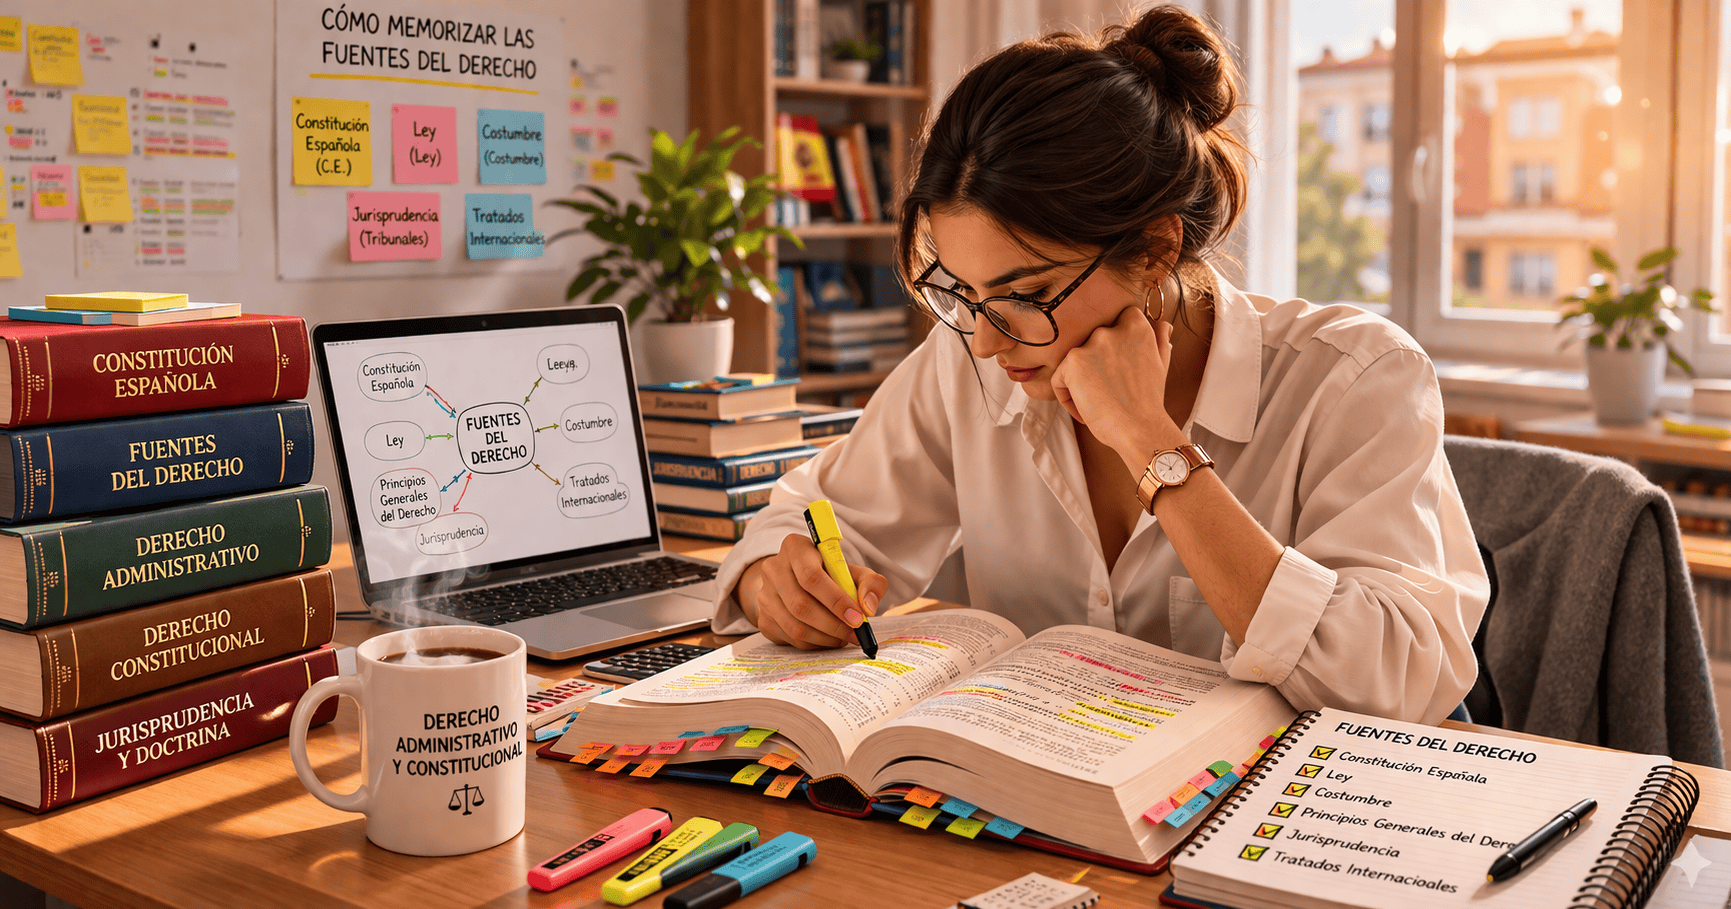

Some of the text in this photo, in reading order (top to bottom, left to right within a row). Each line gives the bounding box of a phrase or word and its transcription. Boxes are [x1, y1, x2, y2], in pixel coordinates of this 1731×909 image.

[322, 4, 534, 49] CÓMO MEMORIZAR LAS
[323, 42, 536, 79] FUENTES DEL DERECHO
[296, 113, 369, 131] Constitución
[414, 122, 436, 142] Ley
[482, 124, 542, 141] Costumbre
[306, 136, 360, 154] Española
[316, 158, 351, 176] (C.E.)
[410, 147, 441, 167] (Ley)
[484, 150, 543, 167] (Costumbre)
[353, 207, 438, 226] Jurisprudencia
[472, 208, 524, 223] Tratados
[360, 230, 428, 248] (Tribunales)
[470, 232, 545, 245] Internacionales
[93, 342, 234, 373] CONSTITUCIÓN
[362, 361, 421, 377] Constitución
[115, 371, 216, 397] ESPAÑOLA
[371, 377, 414, 393] Española
[466, 412, 520, 431] FUENTES
[566, 416, 612, 431] Costumbre
[386, 435, 403, 448] Ley
[486, 431, 507, 444] DEL
[129, 435, 216, 462] FUENTES
[471, 445, 528, 465] DERECHO
[111, 457, 243, 491] DEL DERECHO
[570, 473, 609, 487] Tratados
[380, 477, 426, 492] Principios
[381, 490, 428, 506] Generales
[562, 489, 626, 508] Internacionales
[381, 505, 436, 522] del Derecho
[136, 524, 225, 557] DERECHO
[420, 523, 484, 548] Jurisprudencia
[103, 544, 259, 588] ADMINISTRATIVO
[144, 610, 232, 646] DERECHO
[111, 628, 264, 680] CONSTITUCIONAL
[95, 692, 254, 753] JURISPRUDENCIA
[424, 705, 499, 731] DERECHO
[118, 722, 231, 769] Y DOCTRINA
[396, 721, 516, 753] ADMINISTRATIVO
[1335, 722, 1536, 763] FUENTES DEL DERECHO
[392, 742, 522, 776] Y CONSTITUCIONAL
[1339, 752, 1422, 774] Constitución
[1327, 770, 1353, 783] Ley
[1315, 788, 1392, 807] Costumbre
[1301, 807, 1368, 825] Principios
[1374, 819, 1446, 838] Generales
[1451, 832, 1475, 843] del
[1287, 829, 1400, 857] Jurisprudencia
[1275, 851, 1457, 893] Tratados Internacioales
